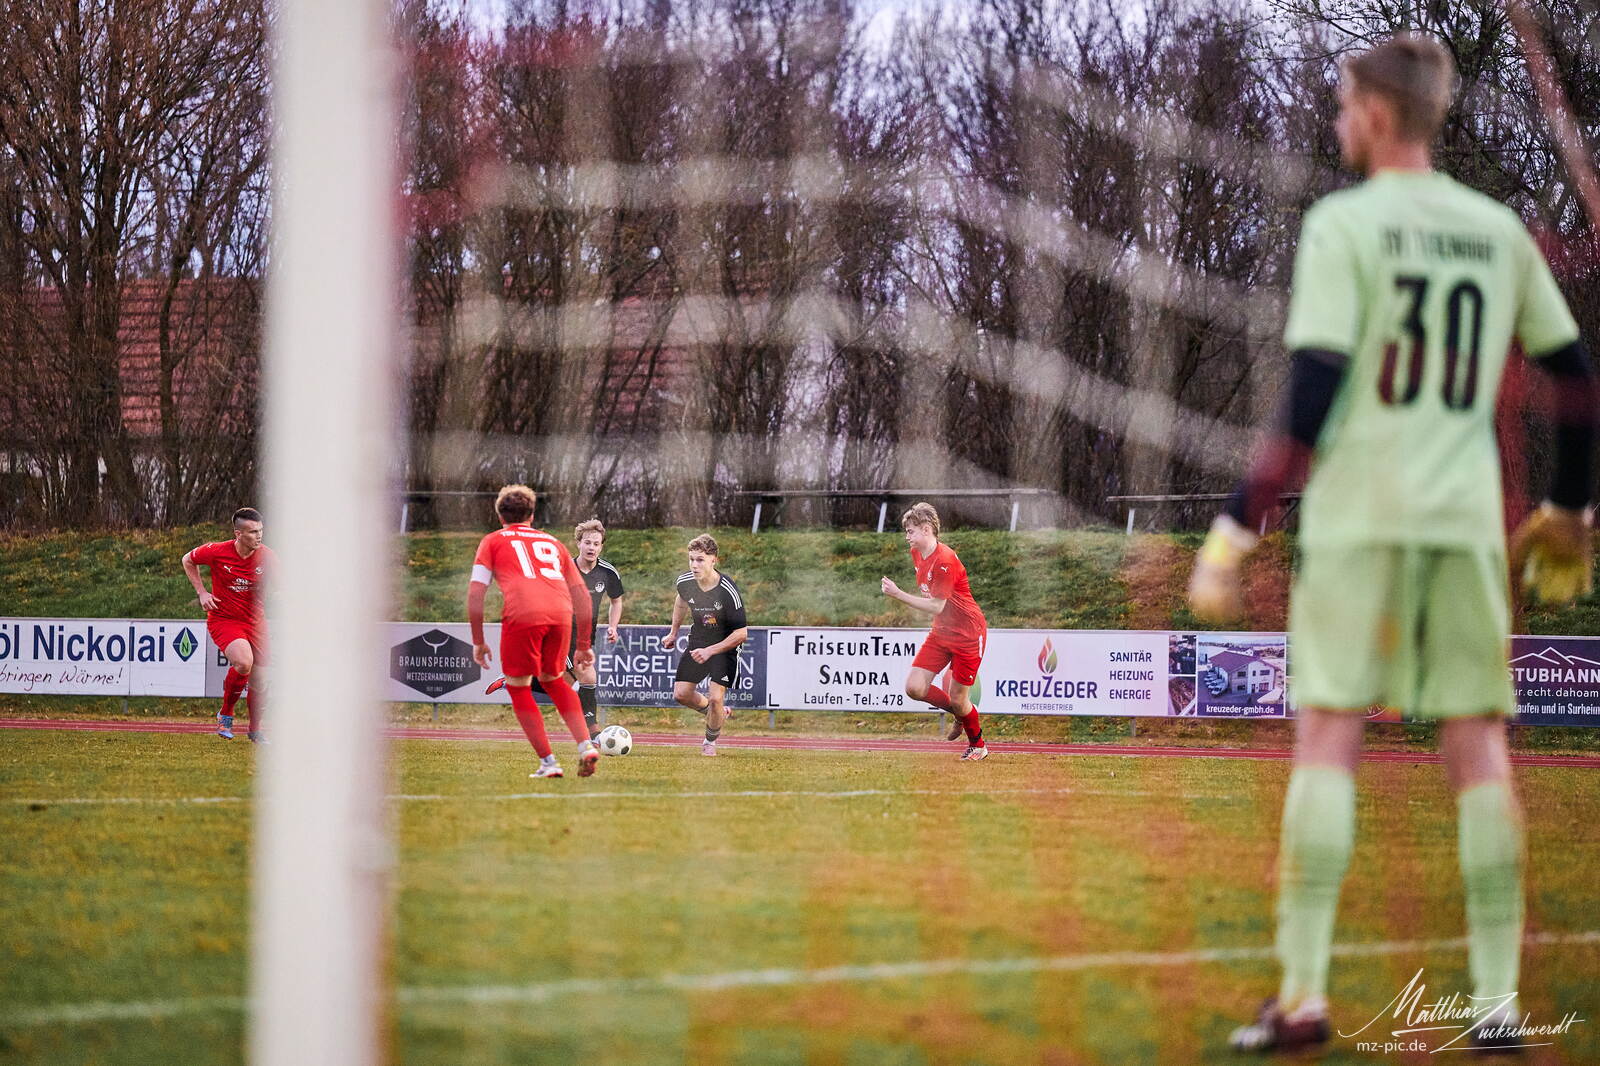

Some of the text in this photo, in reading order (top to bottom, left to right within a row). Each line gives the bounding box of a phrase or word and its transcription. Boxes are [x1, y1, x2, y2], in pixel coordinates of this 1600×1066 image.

[1376, 273, 1485, 411] 30
[510, 540, 565, 581] 19
[33, 624, 165, 662] Nickolai
[1109, 649, 1153, 662] SANITÄR
[598, 654, 754, 675] ENGELN
[60, 665, 123, 685] Wärme!
[406, 671, 464, 682] METZGERHANDWERK
[598, 674, 652, 688] LAUFEN
[819, 664, 890, 685] SANDRA
[1109, 670, 1154, 681] HEIZUNG
[995, 675, 1098, 699] KREUZEDER
[804, 692, 843, 704] Laufen
[853, 693, 879, 705] Tel.:
[882, 694, 904, 706] 478
[1109, 689, 1152, 700] ENERGIE
[1020, 703, 1074, 711] MEISTERBETRIEB
[1206, 704, 1275, 716] kreuzeder-gmbh.de
[1541, 702, 1556, 714] und
[1558, 702, 1566, 714] in
